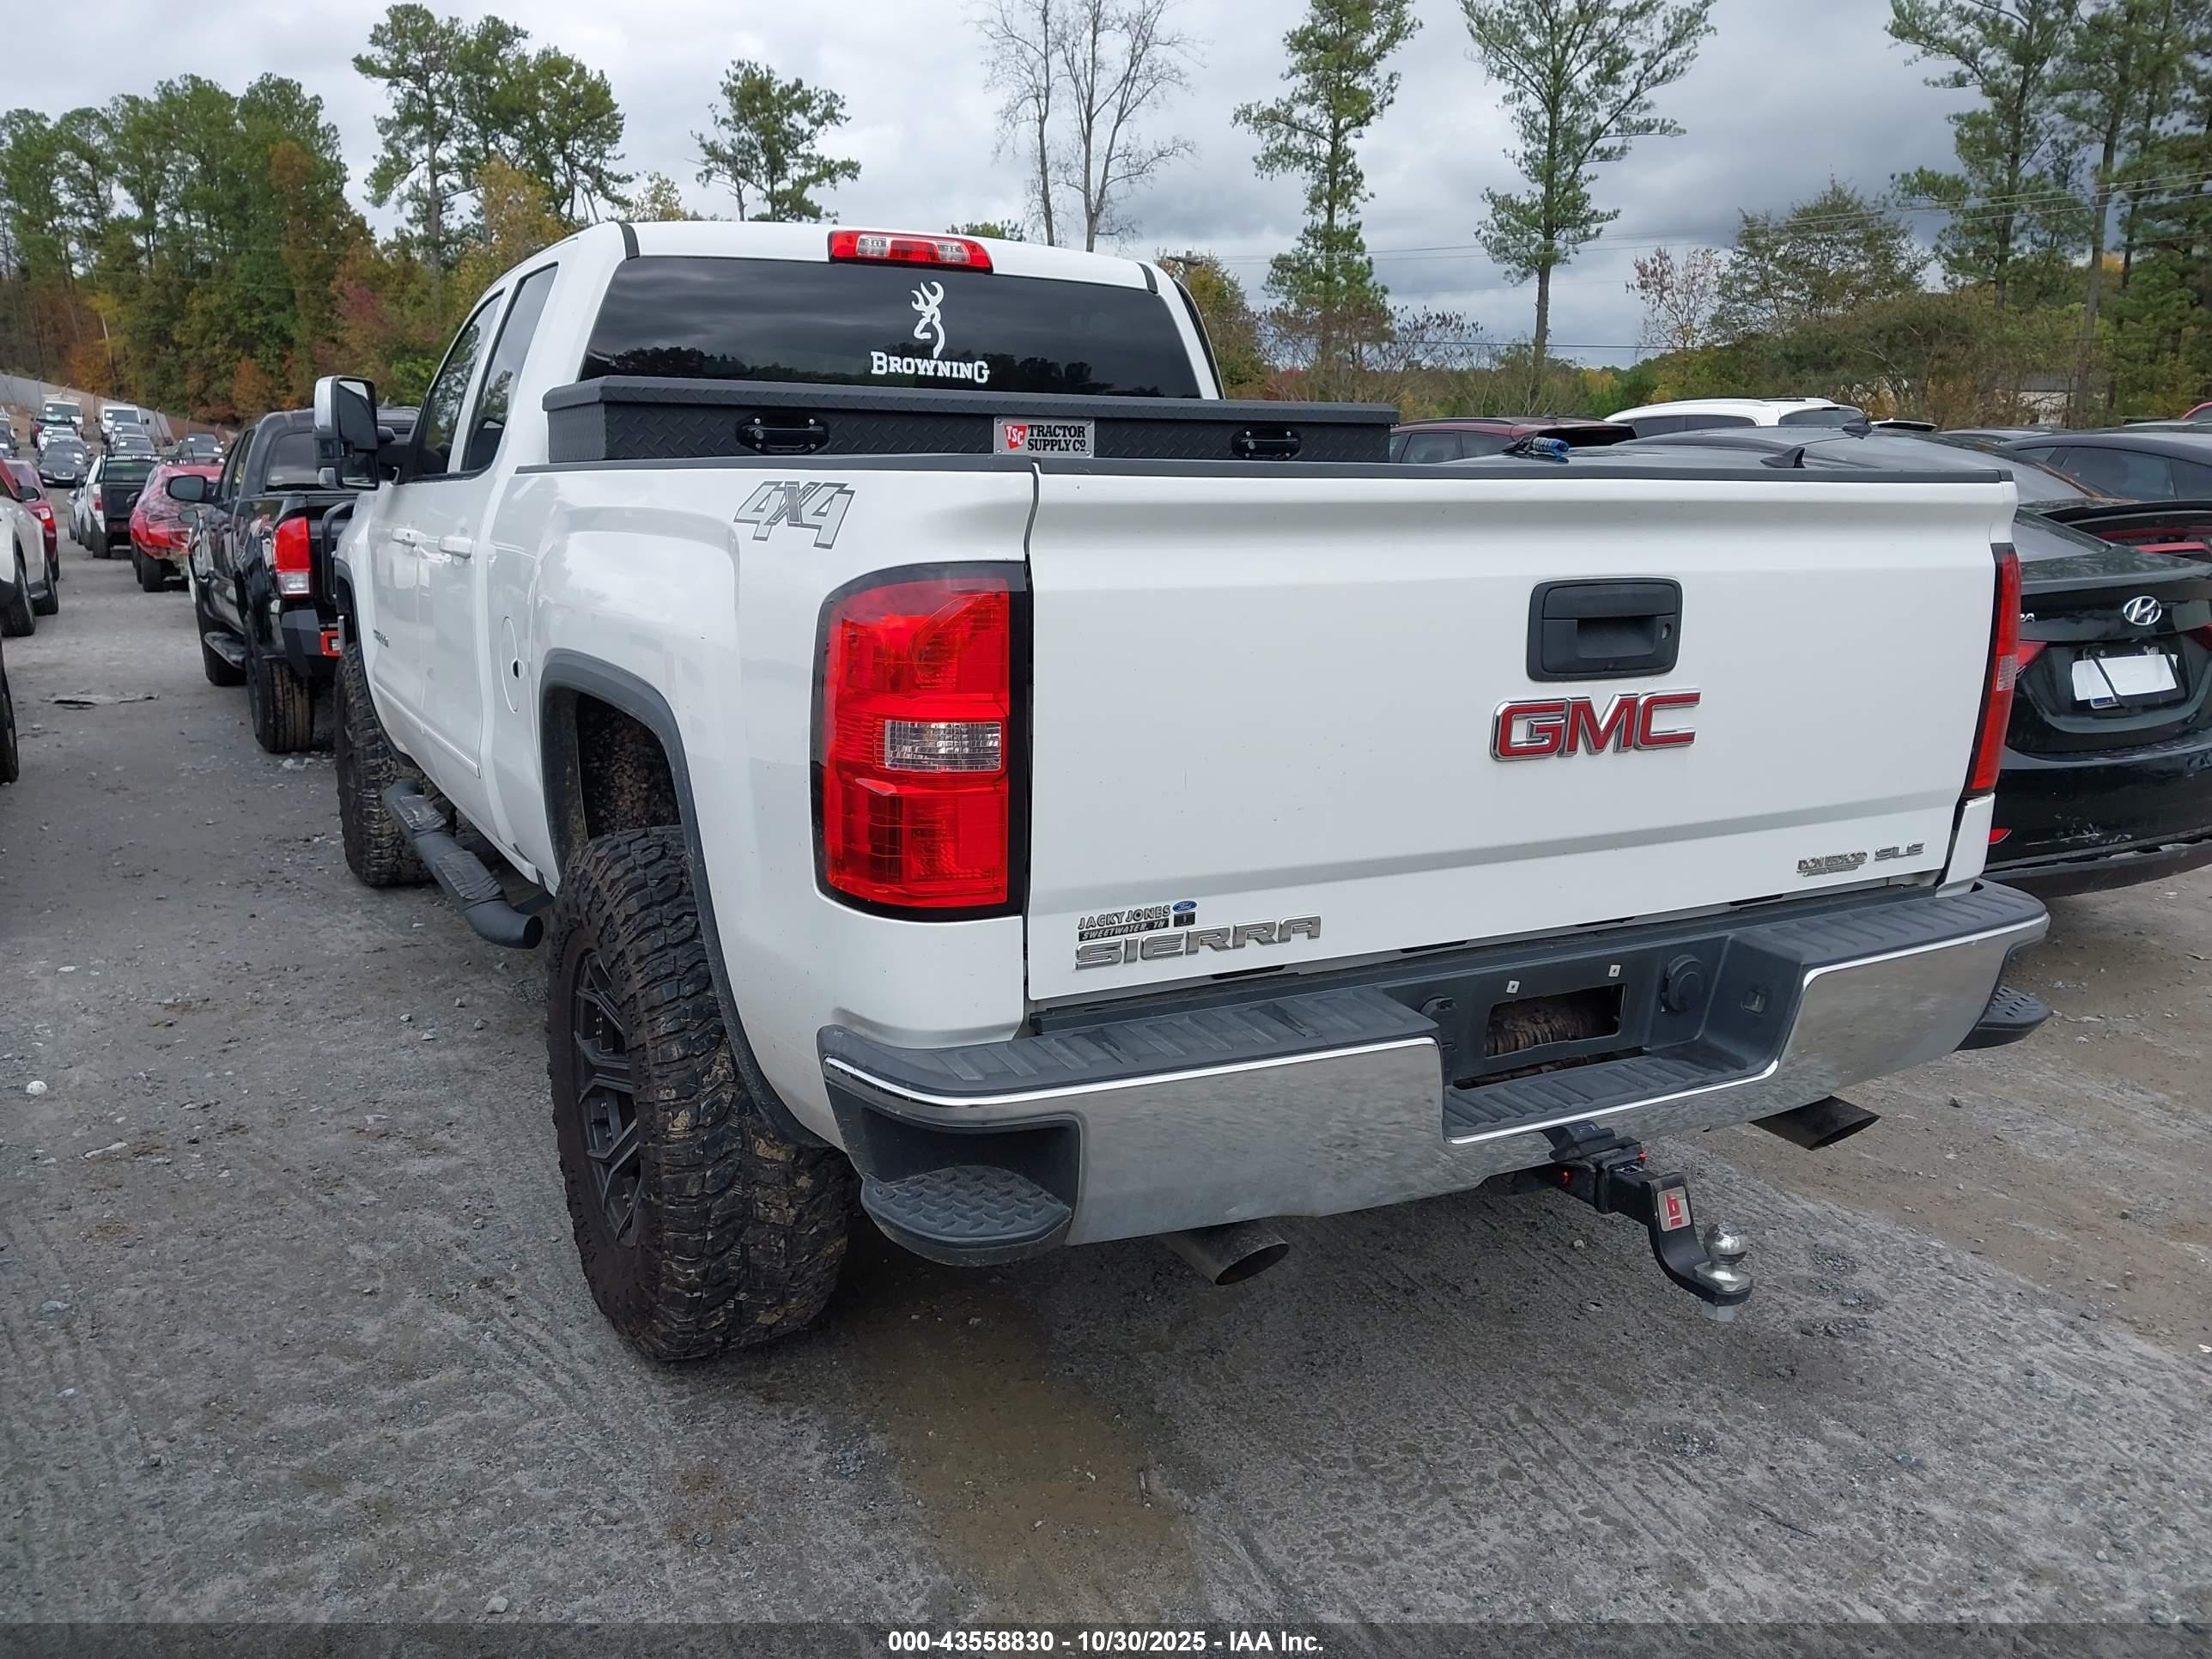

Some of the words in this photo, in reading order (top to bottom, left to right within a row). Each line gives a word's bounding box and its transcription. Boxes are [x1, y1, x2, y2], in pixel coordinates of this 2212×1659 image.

[870, 350, 990, 383] BROWNING
[1006, 426, 1024, 446] TSC
[1027, 424, 1086, 439] TRACTOR
[1027, 439, 1073, 452] SUPPLY
[1490, 687, 1701, 762] GMC
[1875, 842, 1925, 861] SLE
[1078, 911, 1125, 929] JACKY
[1125, 905, 1170, 923] JONES
[1075, 914, 1322, 970] SIERRA
